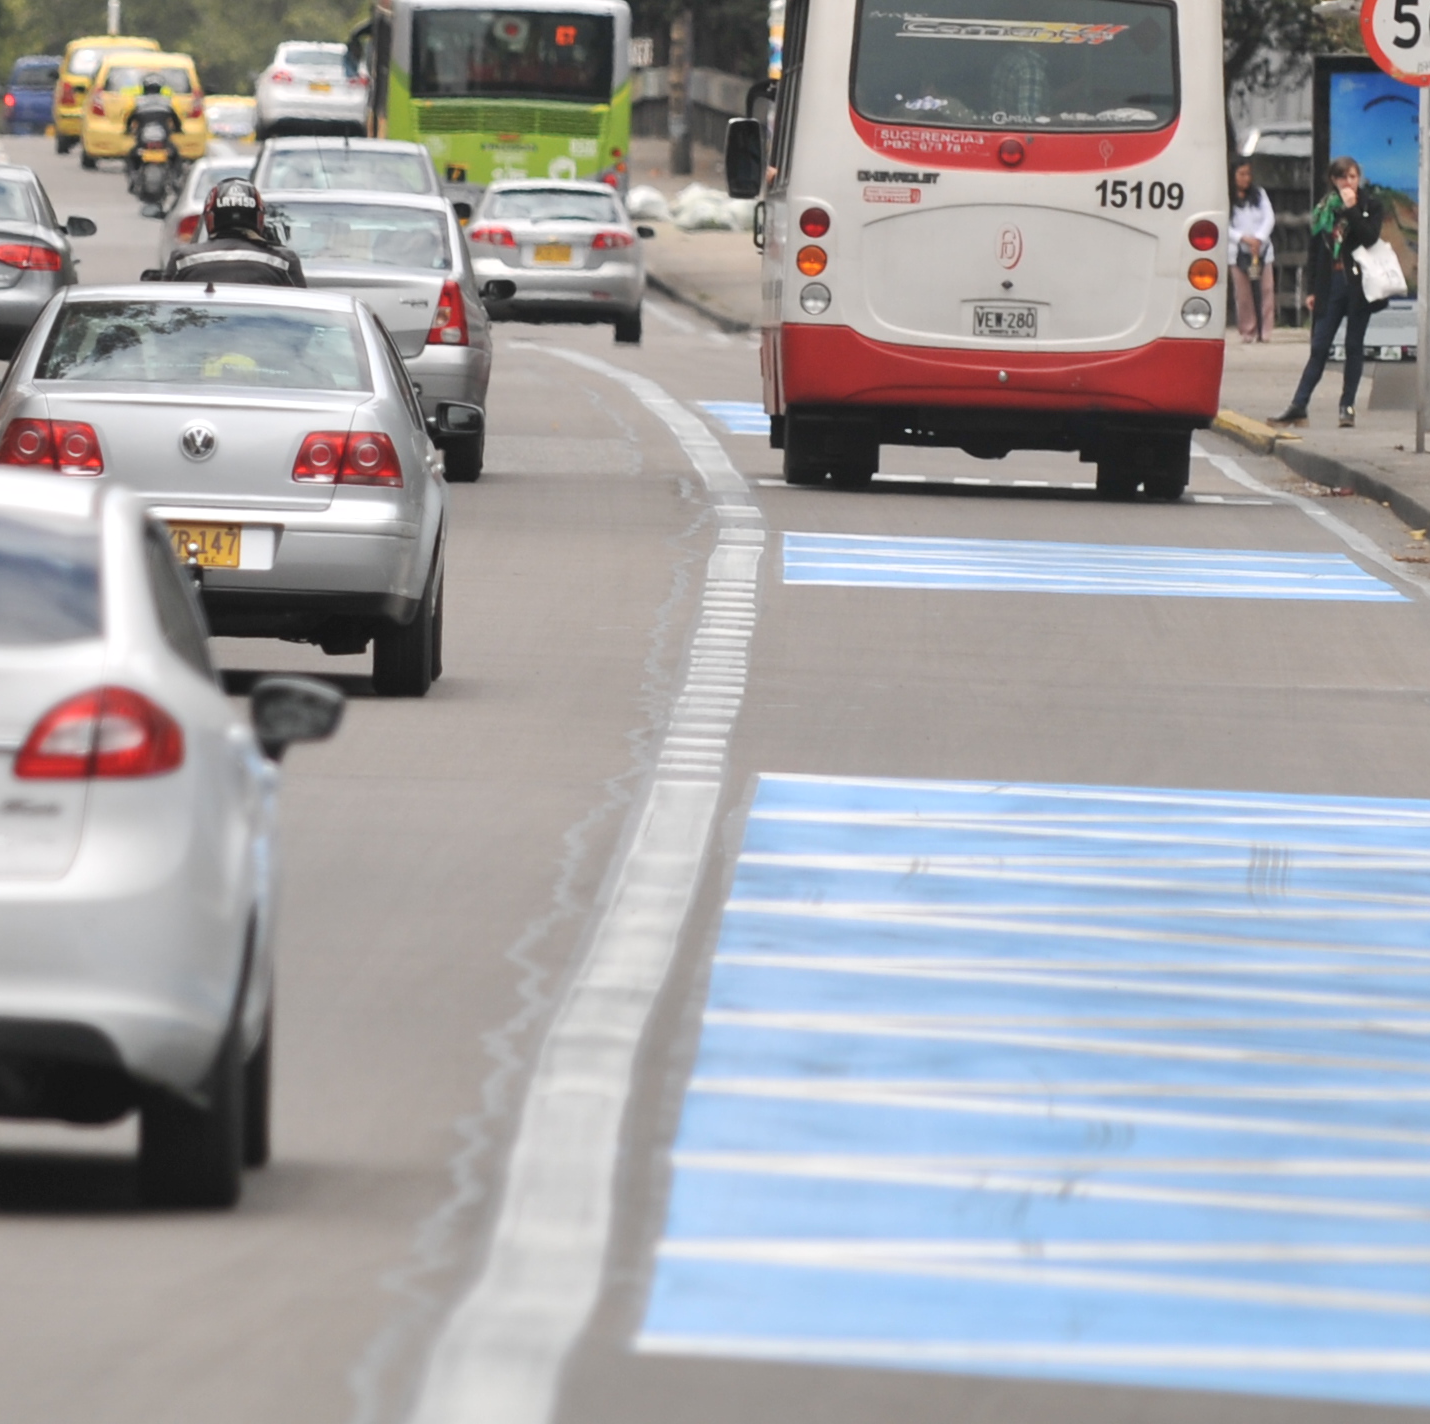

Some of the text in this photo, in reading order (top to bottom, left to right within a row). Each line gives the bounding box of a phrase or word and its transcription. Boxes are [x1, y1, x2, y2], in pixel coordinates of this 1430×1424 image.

[856, 170, 940, 184] CHEVROLET
[1095, 179, 1185, 211] 15109
[975, 311, 1035, 329] VEW-280
